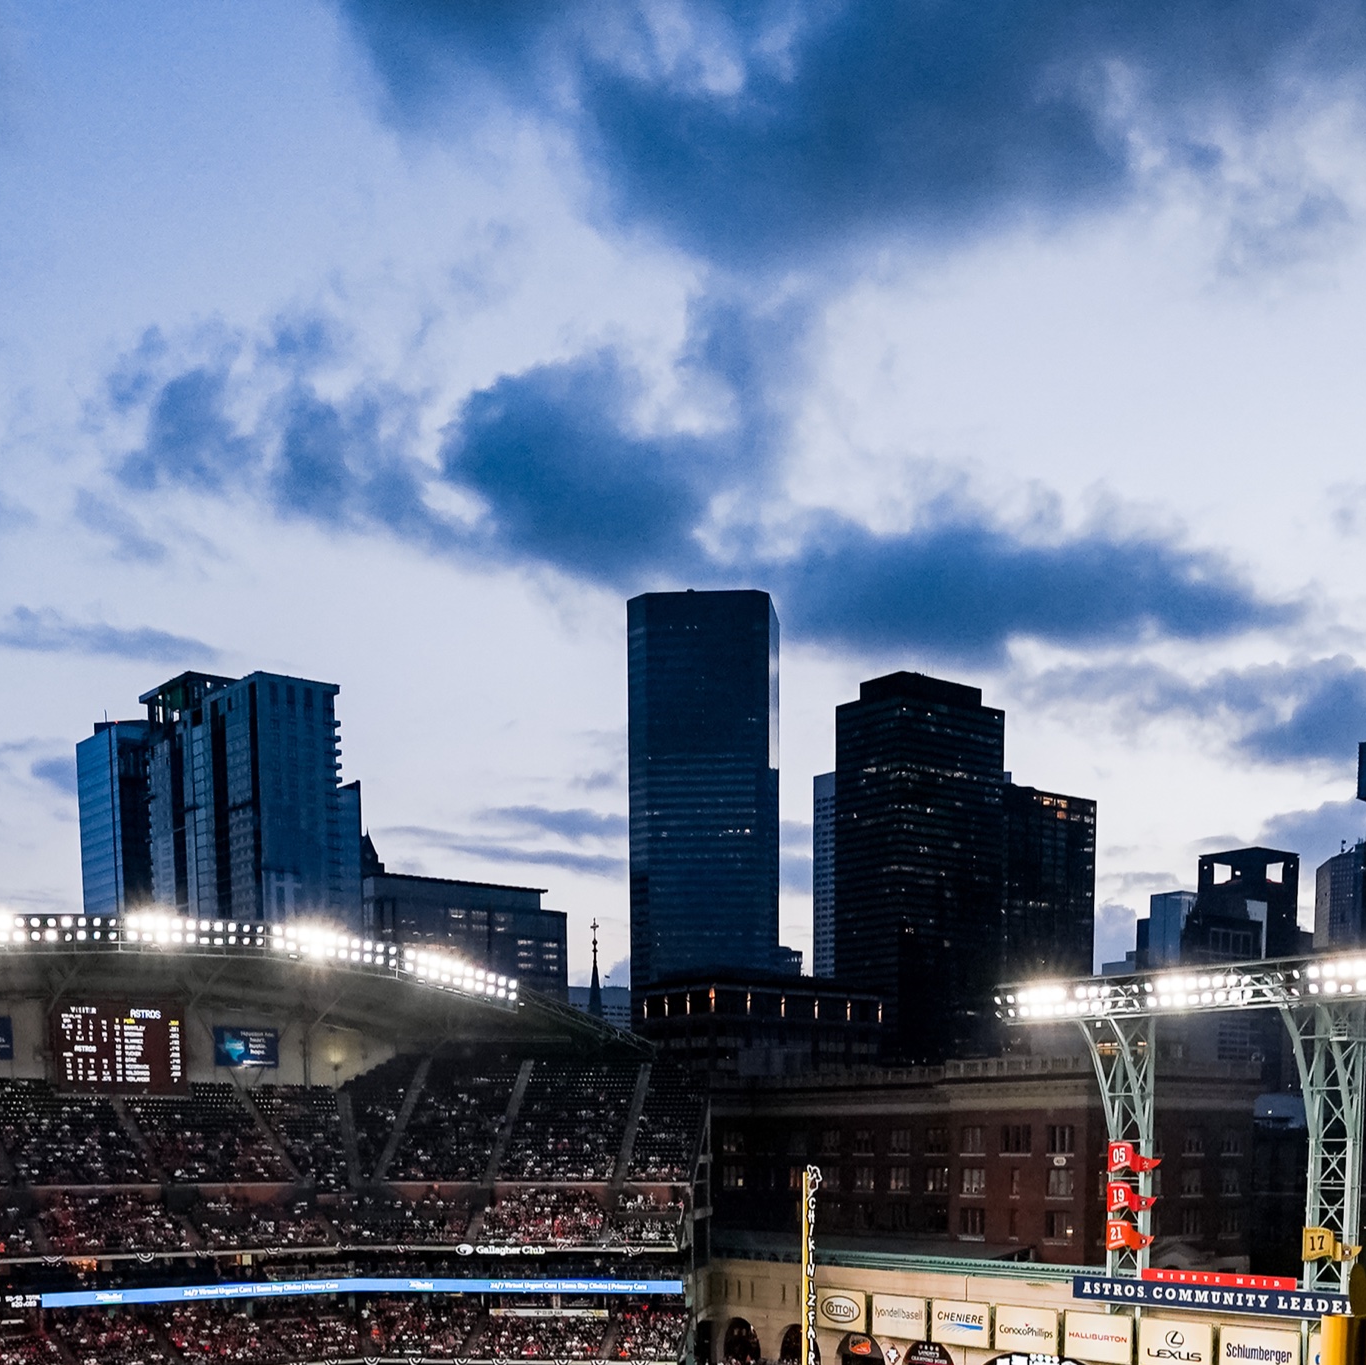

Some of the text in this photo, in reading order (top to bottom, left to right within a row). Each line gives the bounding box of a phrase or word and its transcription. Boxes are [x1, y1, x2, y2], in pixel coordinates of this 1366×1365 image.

[130, 1009, 161, 1019] ASTROS
[1112, 1147, 1126, 1163] 05
[1112, 1189, 1125, 1203] 19
[807, 1197, 817, 1278] CHIKIN
[1110, 1227, 1123, 1240] 21
[476, 1245, 546, 1256] Gallagher Club
[1309, 1235, 1325, 1251] 17
[1157, 1272, 1220, 1283] MINUTE
[807, 1280, 817, 1307] IZ
[1152, 1287, 1268, 1308] COMMUNITY
[875, 1304, 923, 1321] lyondellbasell
[937, 1311, 984, 1325] CHENIERE
[999, 1323, 1053, 1340] ConocoPhillips
[1068, 1331, 1128, 1344] HALLIBURTON
[1147, 1347, 1202, 1363] LEXUS
[1226, 1343, 1292, 1365] Schlumberger
